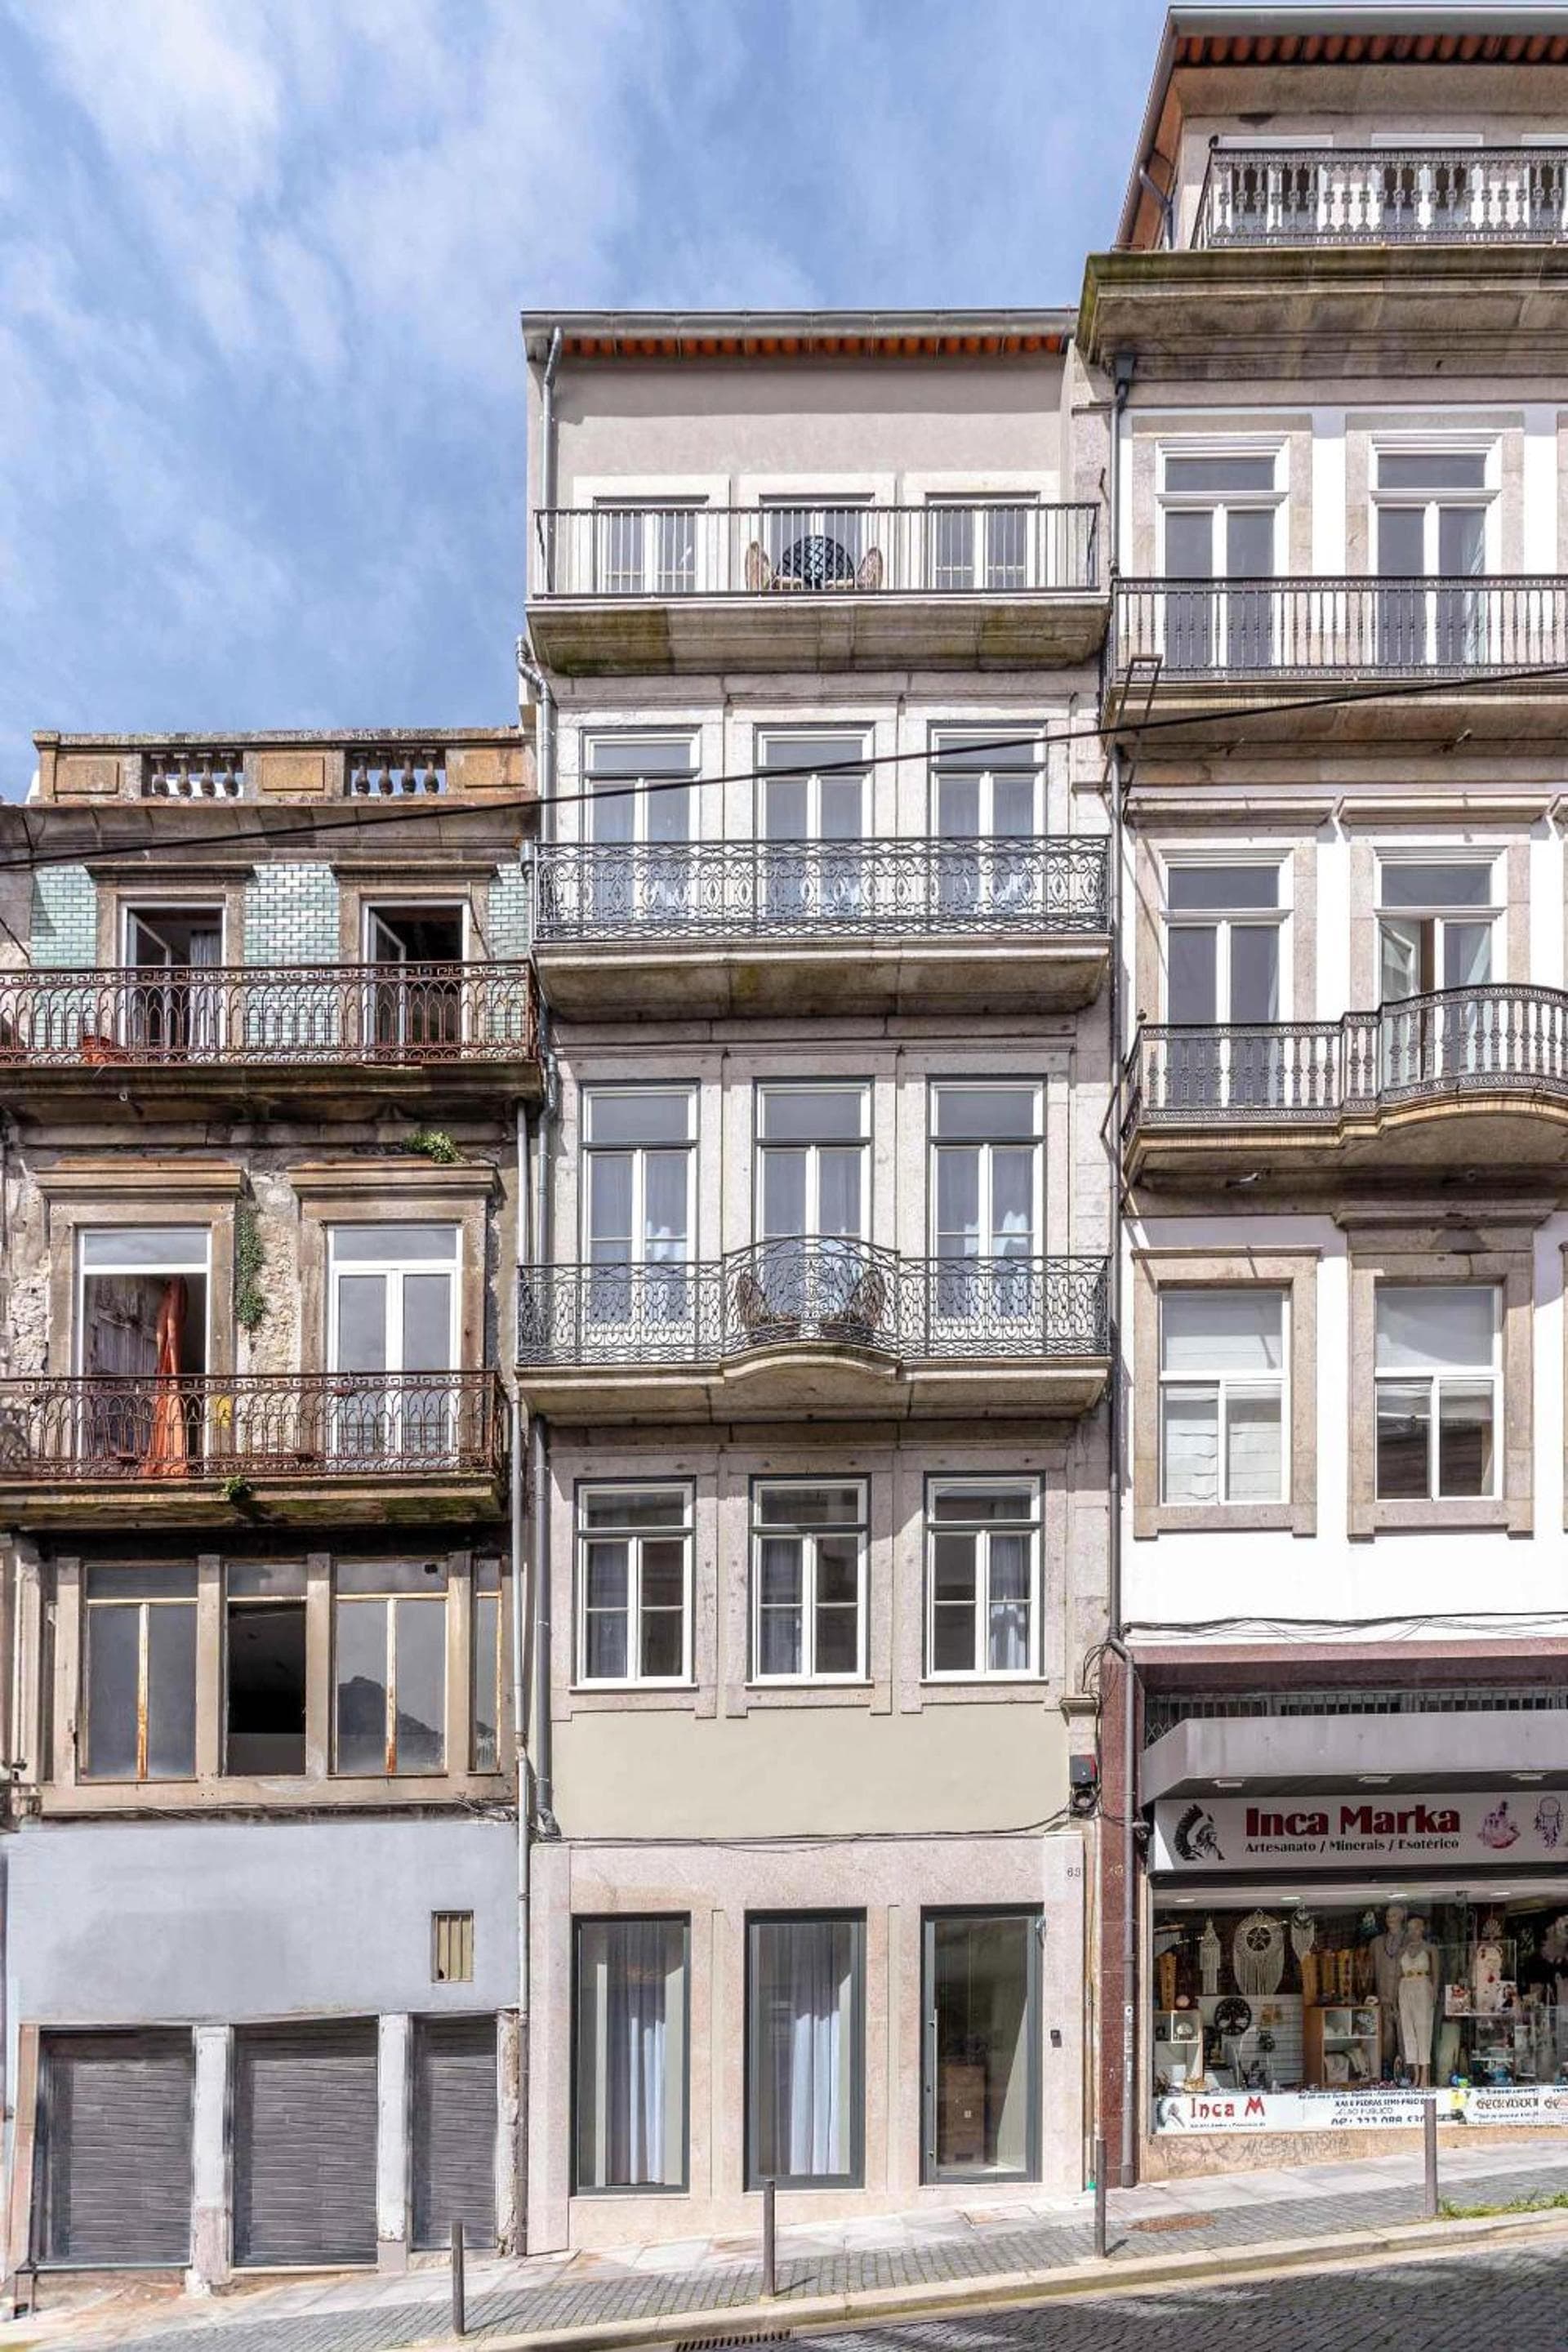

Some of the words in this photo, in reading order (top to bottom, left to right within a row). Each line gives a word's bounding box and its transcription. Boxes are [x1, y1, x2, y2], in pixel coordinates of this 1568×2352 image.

[1246, 1807, 1329, 1837] Inca
[1340, 1805, 1460, 1835] Marka
[1245, 1841, 1316, 1853] Artesanato
[1320, 1840, 1326, 1853] /
[1329, 1838, 1385, 1851] Minerais
[1388, 1838, 1395, 1851] /
[1398, 1838, 1459, 1851] Esotérico
[1191, 2097, 1235, 2119] Inca
